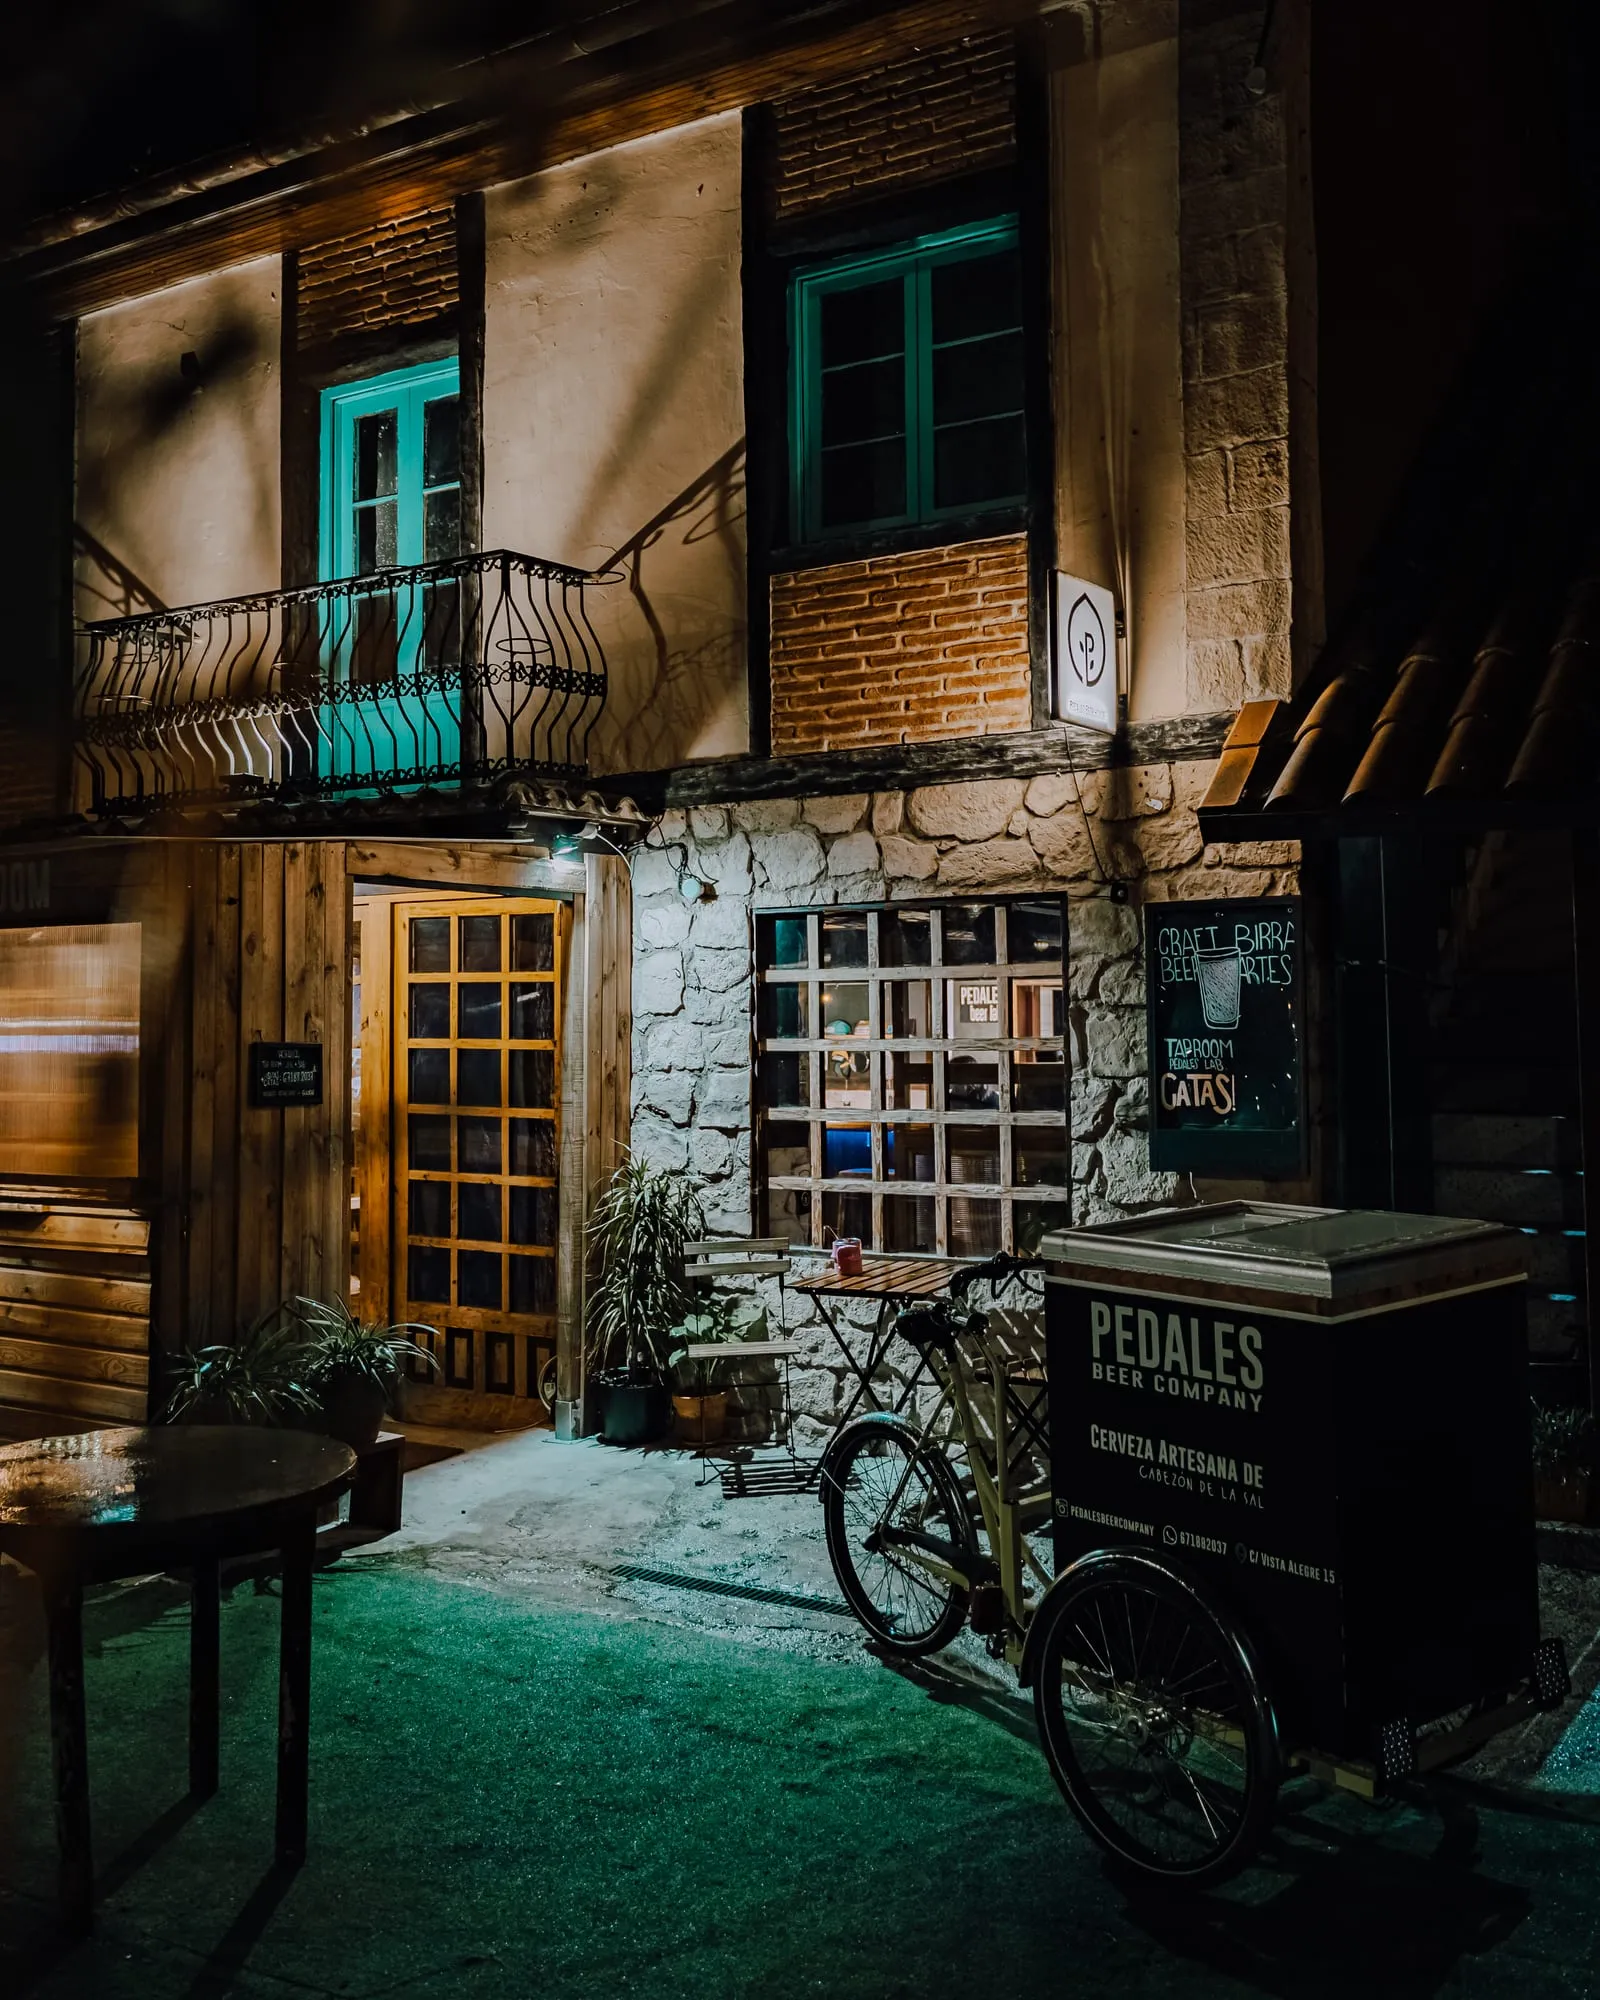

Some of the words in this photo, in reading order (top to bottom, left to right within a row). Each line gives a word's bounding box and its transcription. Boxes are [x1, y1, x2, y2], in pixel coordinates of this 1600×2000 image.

[1158, 926, 1219, 956] CRAFT
[961, 986, 998, 1005] PEDALE
[1165, 1038, 1234, 1059] TAPROOM
[1169, 1058, 1199, 1070] PEDALES
[1160, 1072, 1237, 1115] CATAS!
[1090, 1300, 1264, 1390] PEDALES
[1092, 1363, 1144, 1389] BEER
[1153, 1373, 1264, 1413] COMPANY
[1091, 1423, 1155, 1462] CERVEZA
[1158, 1439, 1238, 1483] ARTESANA
[1244, 1462, 1264, 1489] DE
[1139, 1464, 1193, 1492] CABEZÓN
[1199, 1480, 1214, 1497] DE
[1221, 1486, 1237, 1503] LA
[1243, 1491, 1264, 1509] SAL
[1070, 1505, 1155, 1537] PEDALESBEERCOMPANY
[1249, 1549, 1261, 1566] C/
[1260, 1551, 1286, 1573] VISTA
[1288, 1558, 1321, 1581] ALEGRE
[1323, 1568, 1336, 1585] 15
